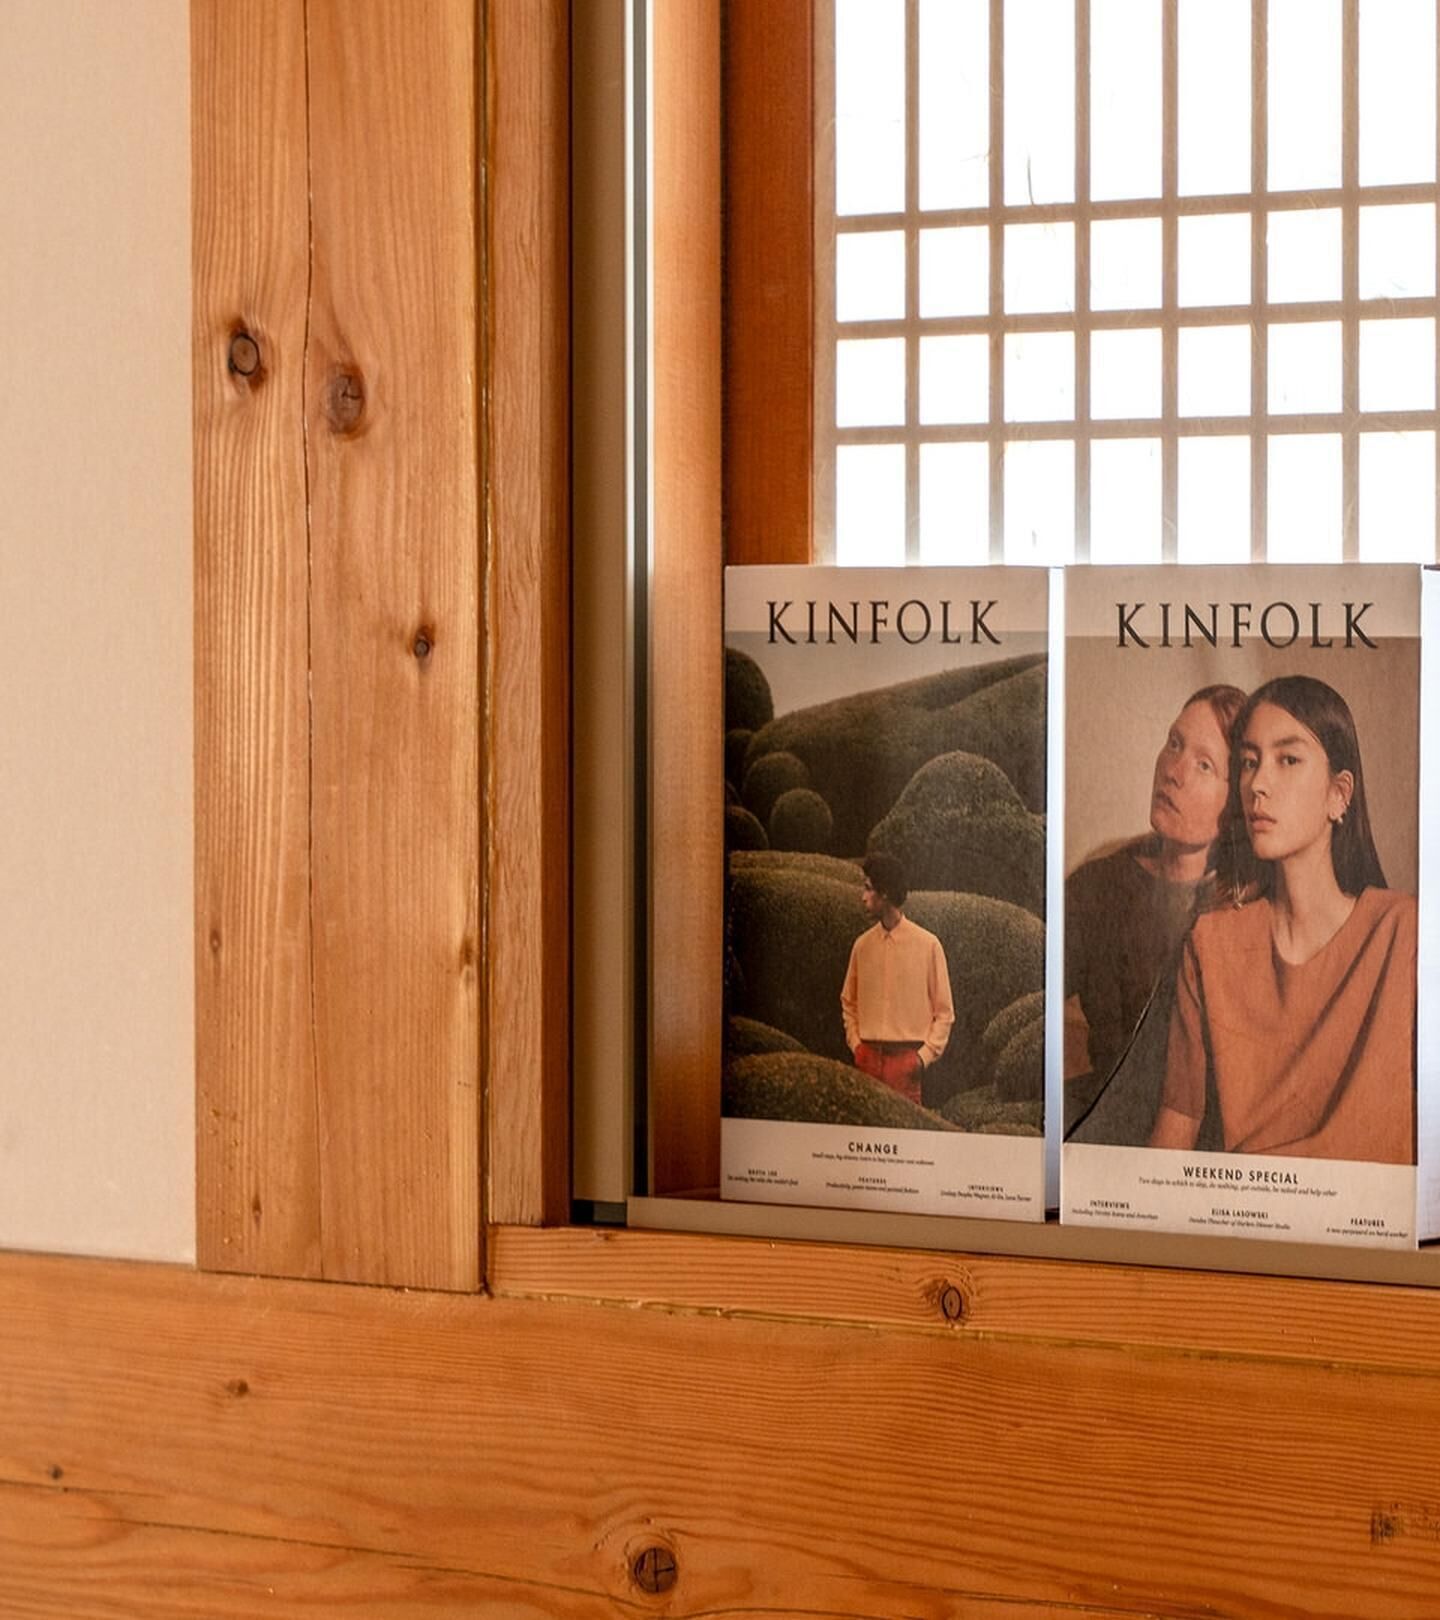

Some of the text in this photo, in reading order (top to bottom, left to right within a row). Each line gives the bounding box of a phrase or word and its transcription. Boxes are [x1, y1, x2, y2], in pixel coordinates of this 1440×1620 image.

[767, 599, 1002, 646] KINFOLK
[1116, 601, 1379, 649] KINFOLK
[848, 1141, 898, 1155] CHANGE
[1183, 1165, 1298, 1185] WEEKEND SPECIAL
[1350, 1218, 1385, 1228] FEATURES
